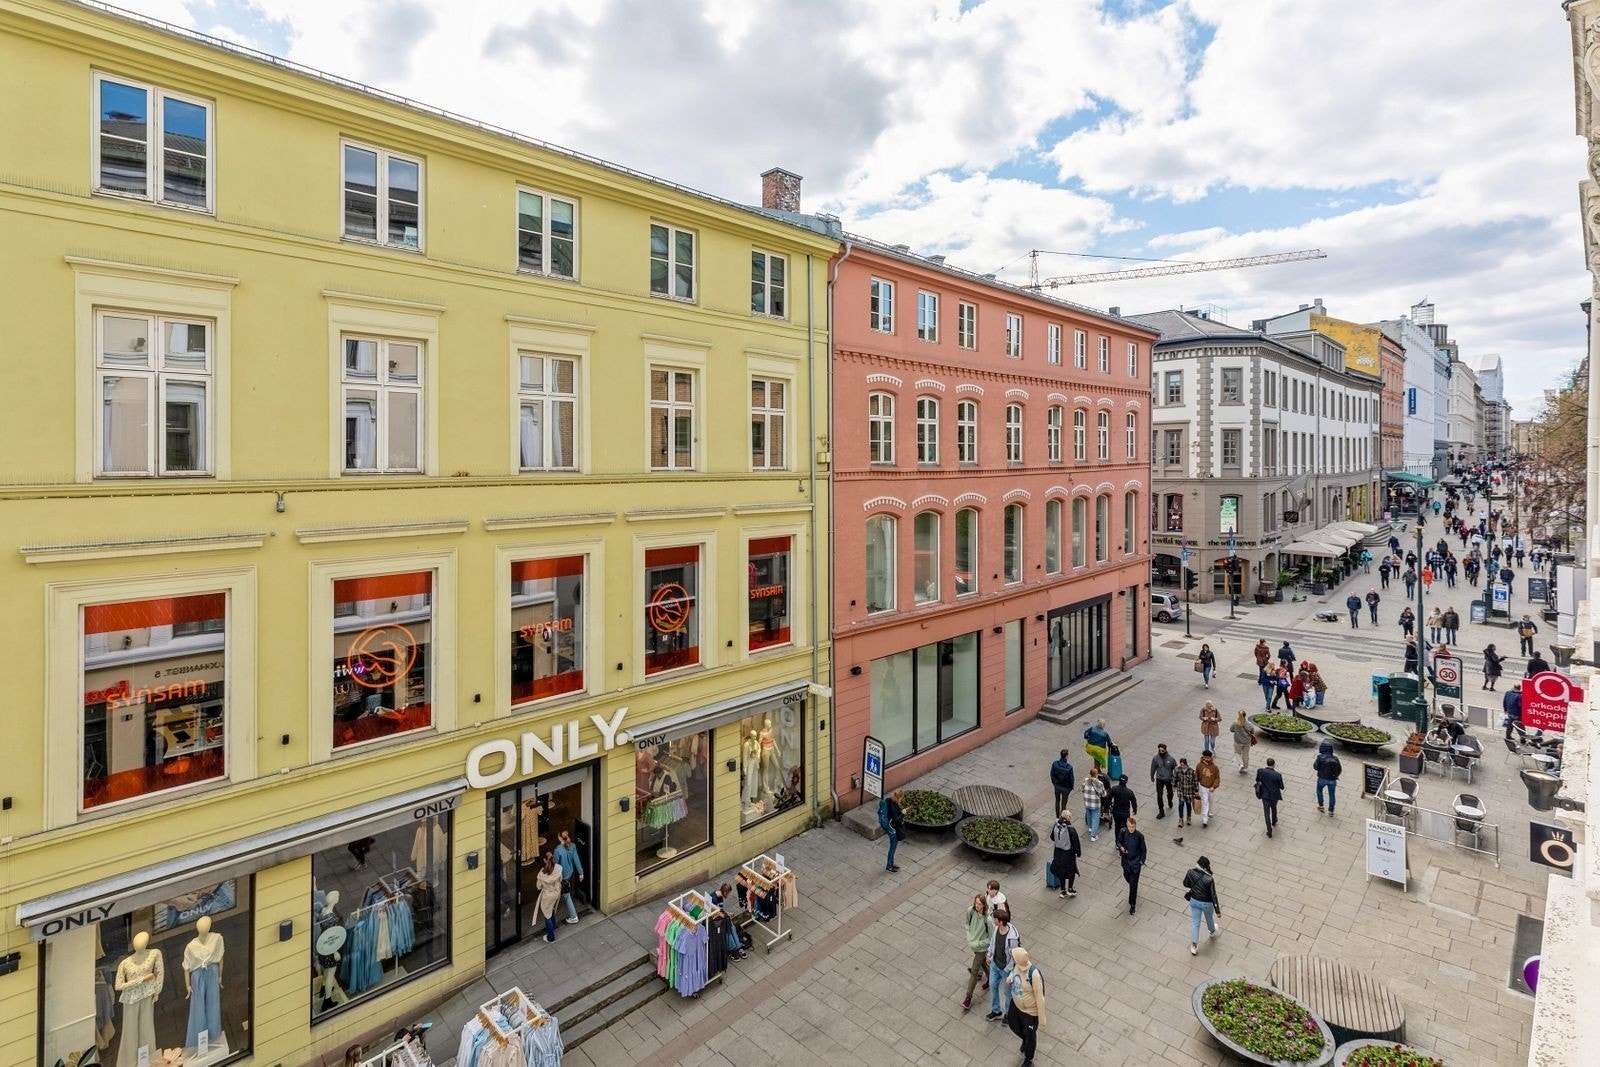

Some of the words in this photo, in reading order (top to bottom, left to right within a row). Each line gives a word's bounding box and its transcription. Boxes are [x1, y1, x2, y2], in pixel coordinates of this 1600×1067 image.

[1442, 670, 1455, 680] 30
[782, 692, 804, 705] ONLY
[638, 734, 666, 750] ONLY
[413, 797, 456, 820] ONLY
[1368, 822, 1403, 836] PANDORA
[42, 902, 117, 937] ONLY
[179, 902, 213, 921] ONLY
